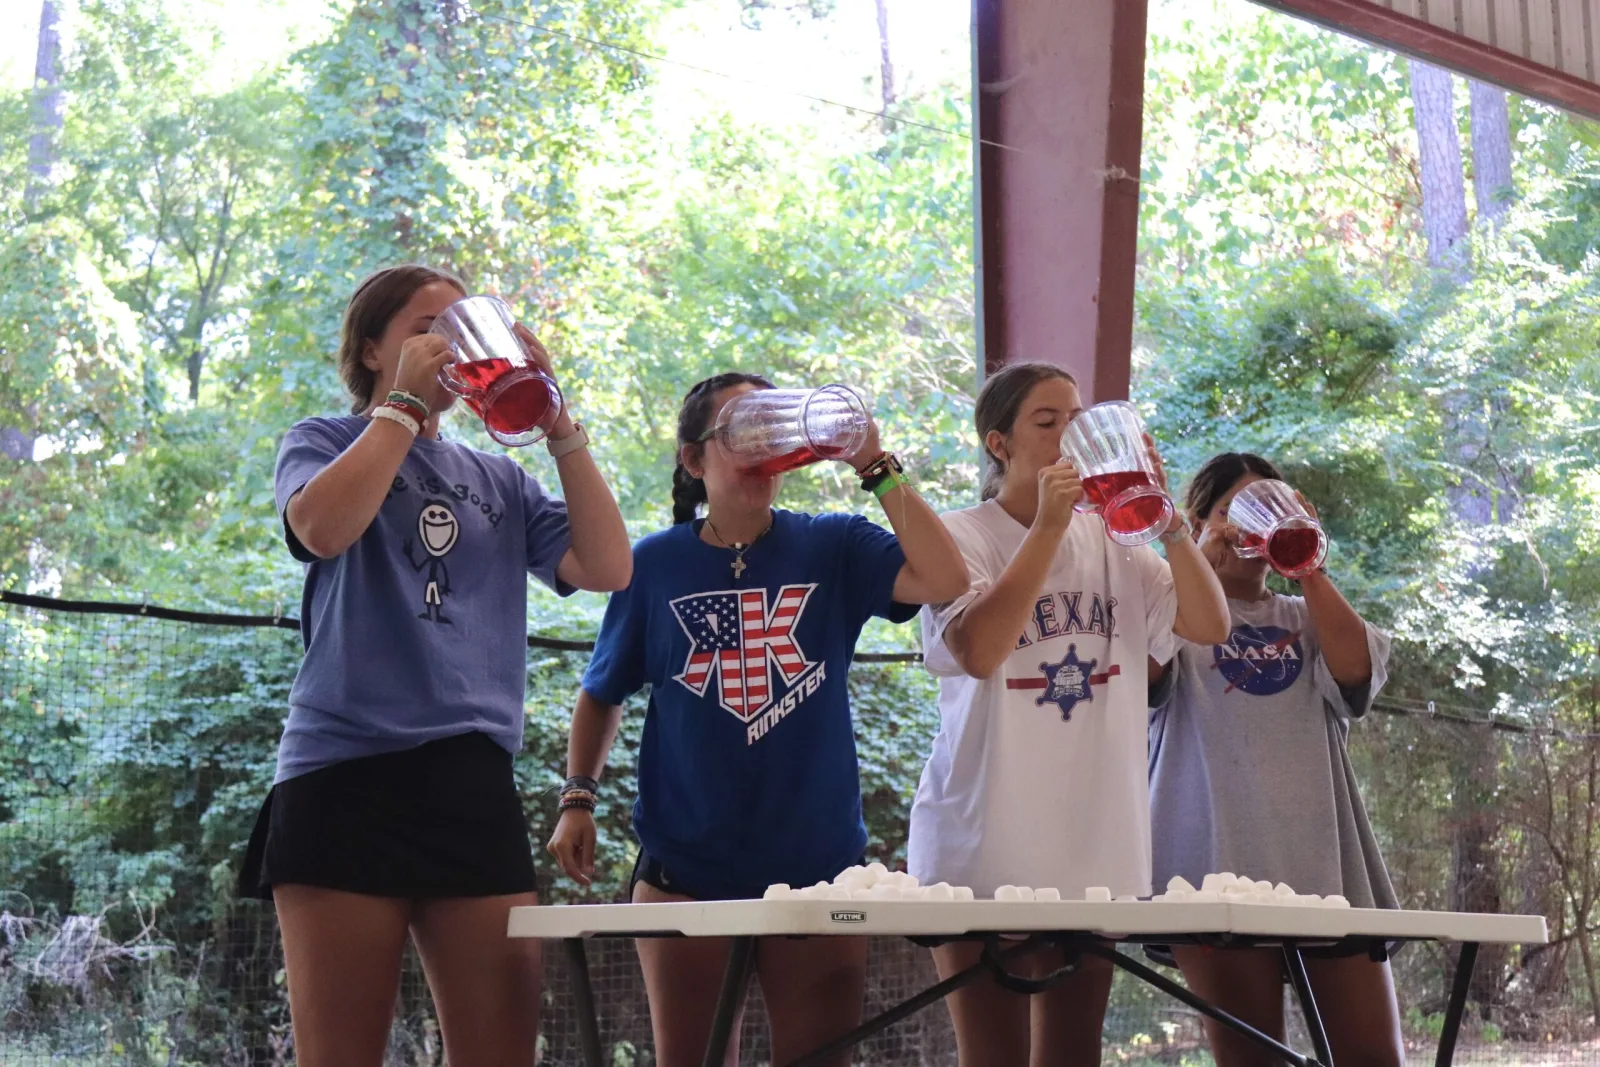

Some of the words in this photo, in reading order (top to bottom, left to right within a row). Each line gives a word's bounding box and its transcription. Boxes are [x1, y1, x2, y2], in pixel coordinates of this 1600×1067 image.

[415, 476, 441, 495] is
[451, 483, 504, 529] good
[1015, 591, 1119, 650] EXAS
[1219, 643, 1301, 660] NASA
[747, 660, 827, 746] RINKSTER
